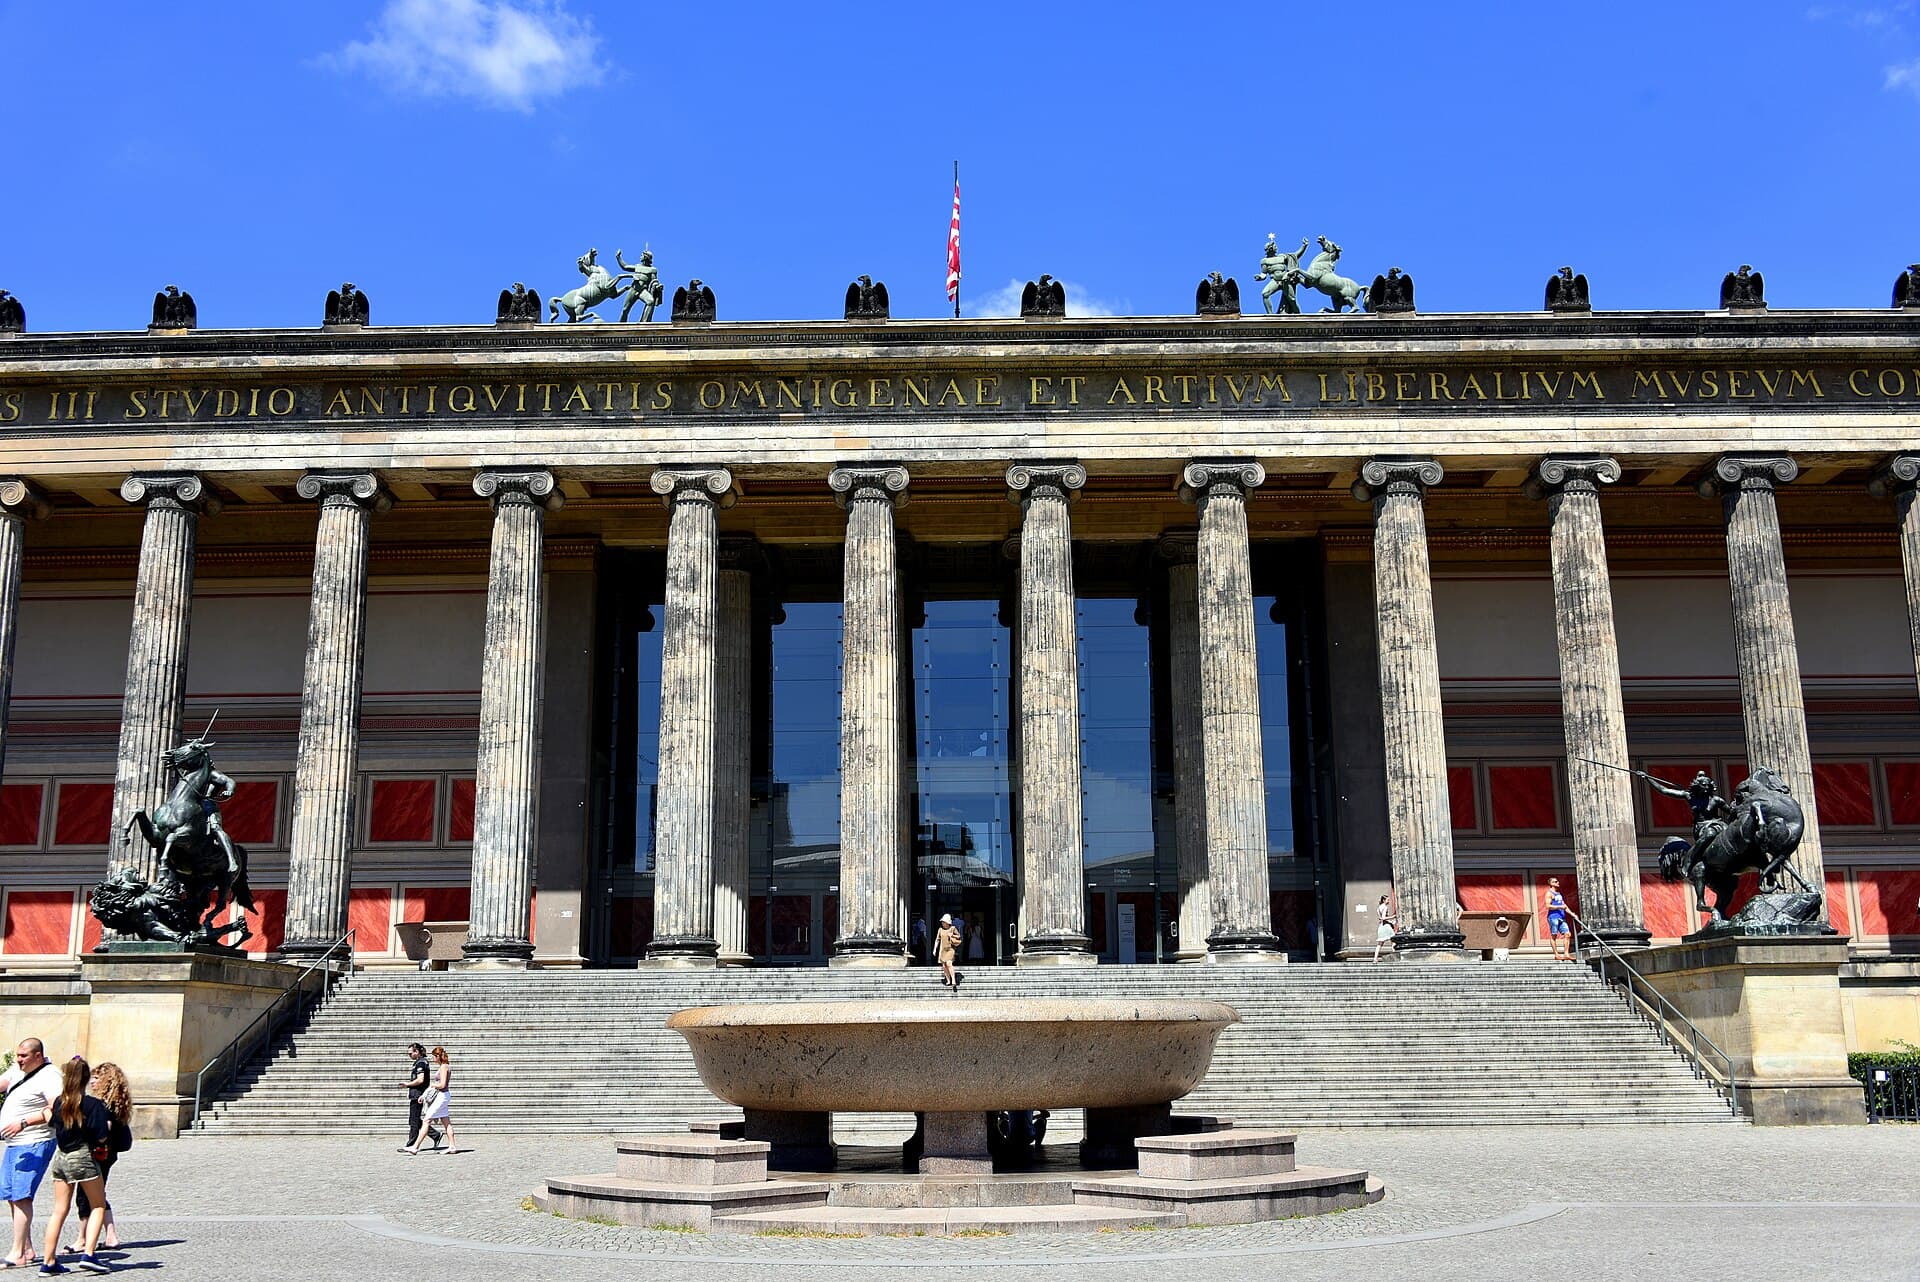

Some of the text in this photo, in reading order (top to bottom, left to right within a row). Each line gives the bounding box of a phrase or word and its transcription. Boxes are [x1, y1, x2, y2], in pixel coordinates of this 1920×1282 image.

[48, 391, 97, 420] III
[125, 388, 295, 418] STVDIO
[325, 381, 672, 415] ANTIQVITATIS
[699, 377, 1001, 409] OMNIGENAE
[1030, 376, 1086, 405] ET
[1107, 374, 1292, 404] ARTIVM
[1318, 371, 1605, 401] LIBERALIVM
[1631, 370, 1824, 399] MVSEVM
[1849, 369, 1920, 397] CO
